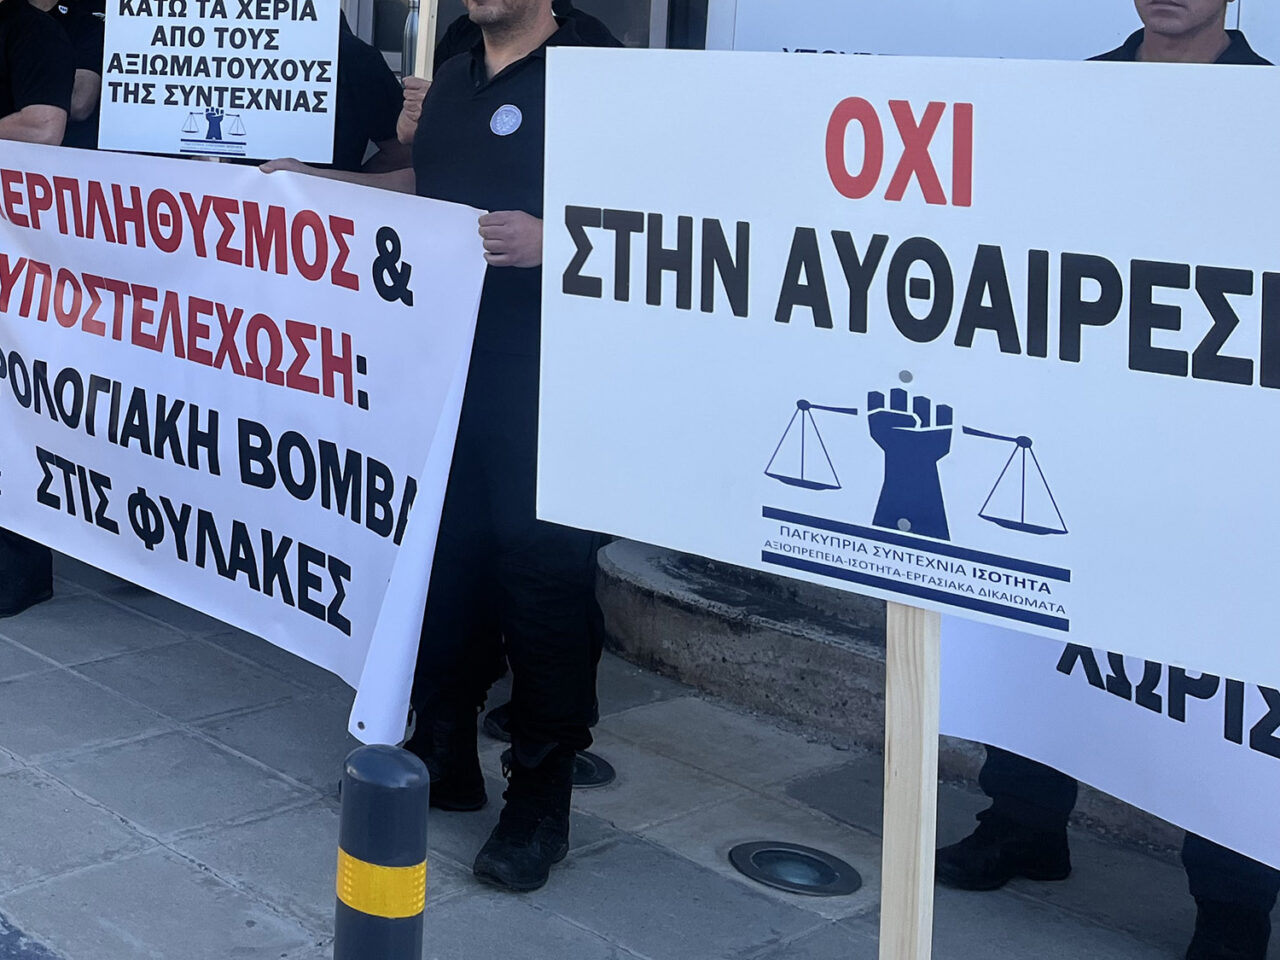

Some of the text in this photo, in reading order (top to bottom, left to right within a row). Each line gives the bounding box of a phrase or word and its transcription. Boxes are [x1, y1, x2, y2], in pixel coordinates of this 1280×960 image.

[107, 53, 332, 83] ΑΞΙΩΜΑΤΟΥΧΟΥΣ
[151, 25, 280, 50] ΑΠΟ ΤΟΥΣ
[108, 81, 328, 113] ΤΗΣ ΣΥΝΤΕΧΝΙΑΣ
[824, 95, 974, 208] ΟΧΙ
[372, 226, 414, 307] &
[561, 204, 751, 319] ΣΤΗΝ
[36, 446, 352, 637] ΣΤΙΣ ΦΥΛΑΚΕΣ
[779, 525, 1052, 596] ΠΑΓΚΥΠΡΙΑ ΣΥΝΤΕΧΝΙΑ ΙΣΟΤΗΤΑ
[978, 587, 1066, 616] ΔΙΚΑΙΩΜΑΤΑ
